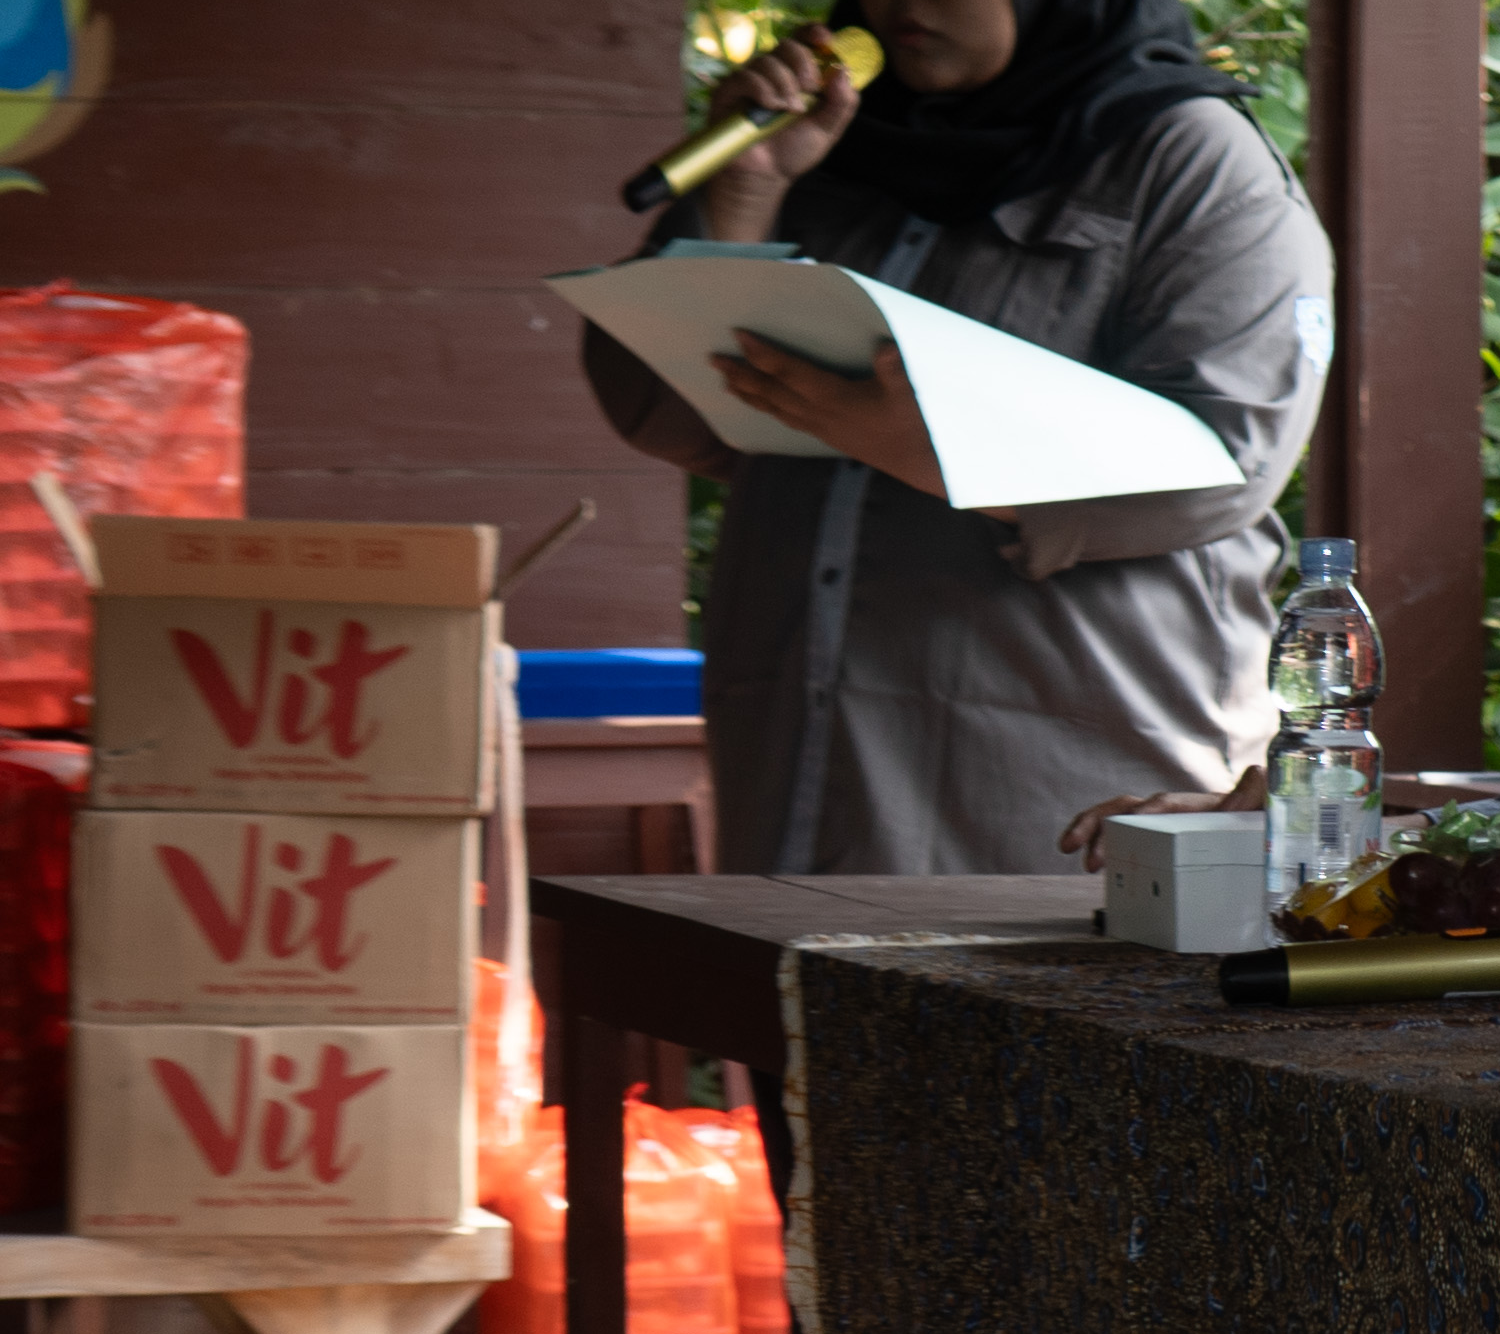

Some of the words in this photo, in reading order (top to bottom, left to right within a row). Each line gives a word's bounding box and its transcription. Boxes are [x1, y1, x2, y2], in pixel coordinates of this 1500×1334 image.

[168, 609, 411, 759] Vit
[154, 822, 399, 972] Vit
[149, 1035, 391, 1184] Vit
